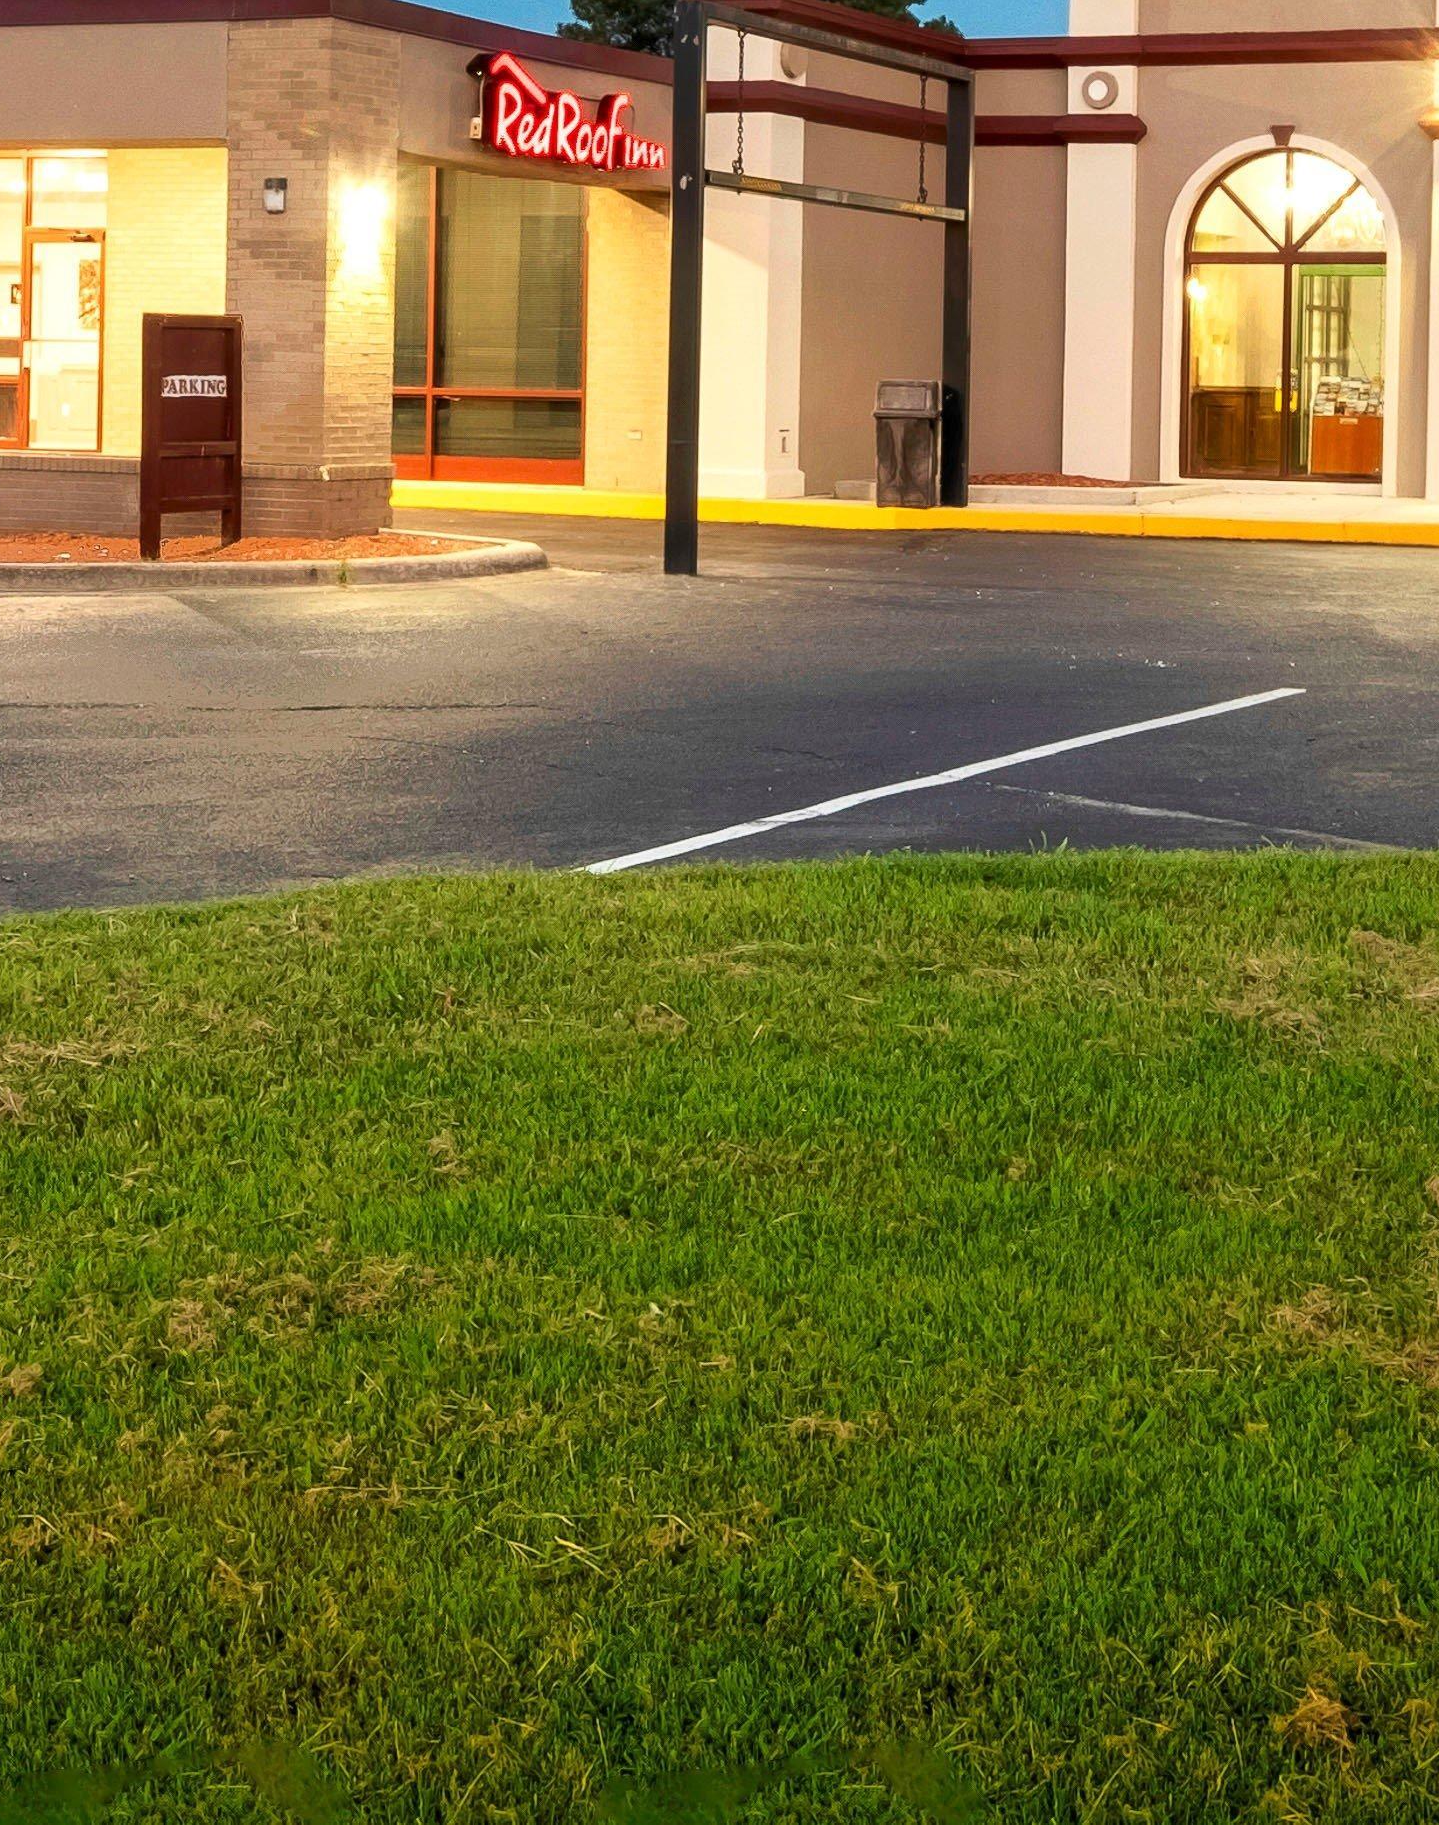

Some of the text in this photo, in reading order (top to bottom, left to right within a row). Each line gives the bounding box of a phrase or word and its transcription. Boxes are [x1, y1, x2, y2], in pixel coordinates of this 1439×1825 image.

[495, 82, 555, 157] Red
[557, 92, 629, 171] Roof
[161, 378, 226, 395] PARKING
